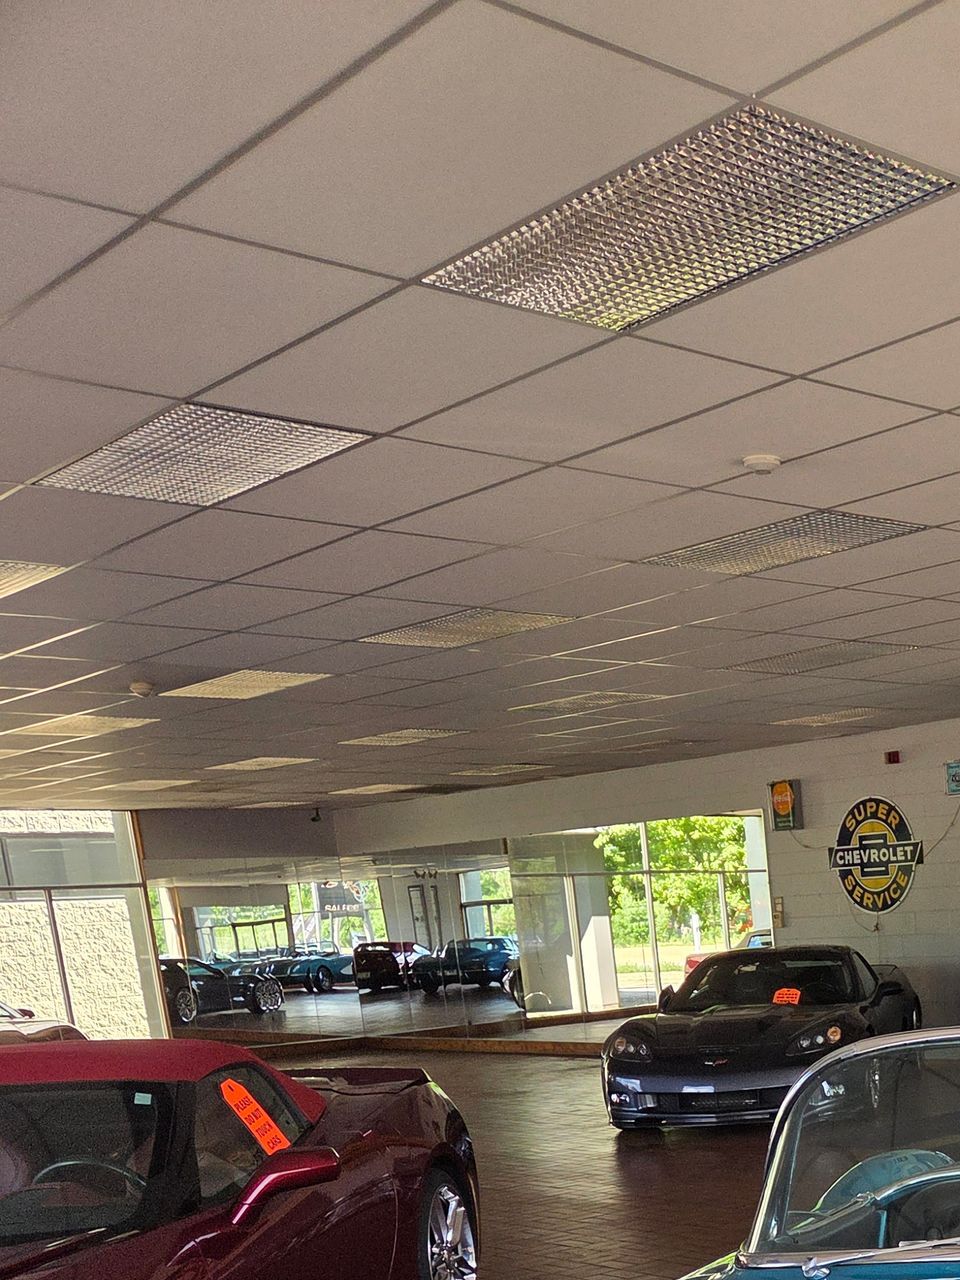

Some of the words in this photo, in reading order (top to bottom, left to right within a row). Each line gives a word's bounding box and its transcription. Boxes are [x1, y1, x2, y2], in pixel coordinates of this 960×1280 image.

[845, 802, 900, 832] SUPER
[836, 845, 914, 866] CHEVROLET
[843, 870, 909, 910] SERVICE
[244, 1115, 256, 1126] DO
[267, 1134, 282, 1150] CARS
